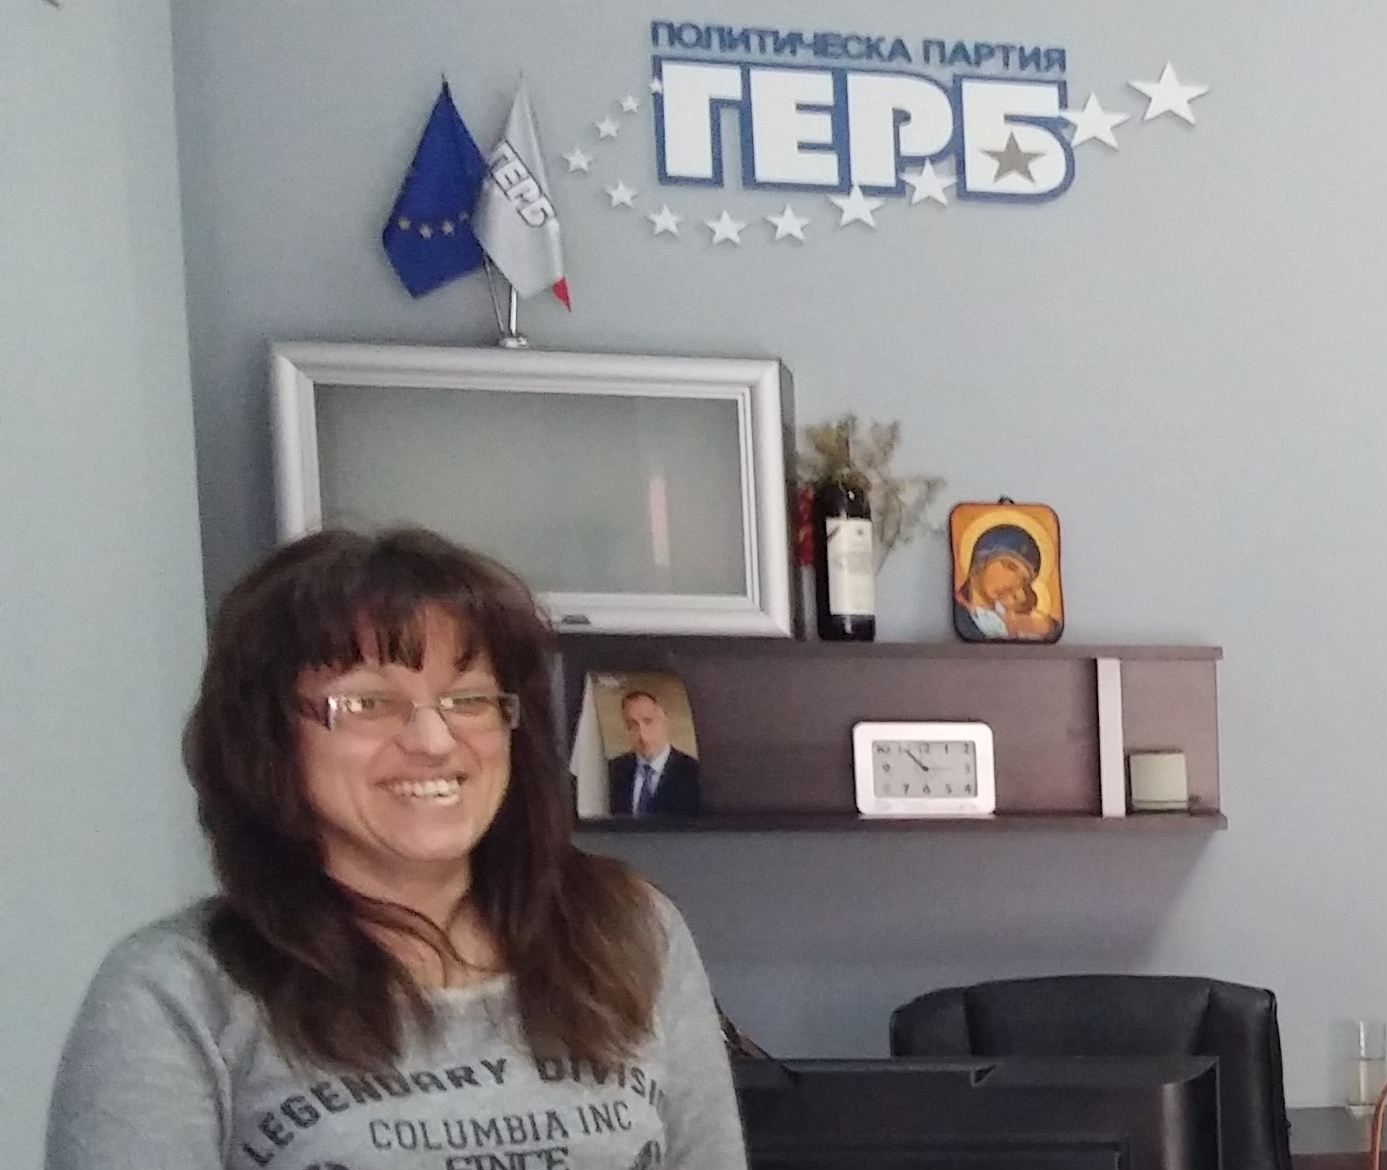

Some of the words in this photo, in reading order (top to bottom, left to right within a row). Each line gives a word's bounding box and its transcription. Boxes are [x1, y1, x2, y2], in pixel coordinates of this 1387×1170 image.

[650, 20, 912, 63] ПОЛИТИЧЕСКА
[923, 38, 1067, 72] ПАРТИЯ
[653, 55, 1076, 200] ГЕРБ
[486, 139, 557, 228] ГЕРБ
[368, 1109, 569, 1152] COLUMBIA
[577, 1100, 634, 1137] INC
